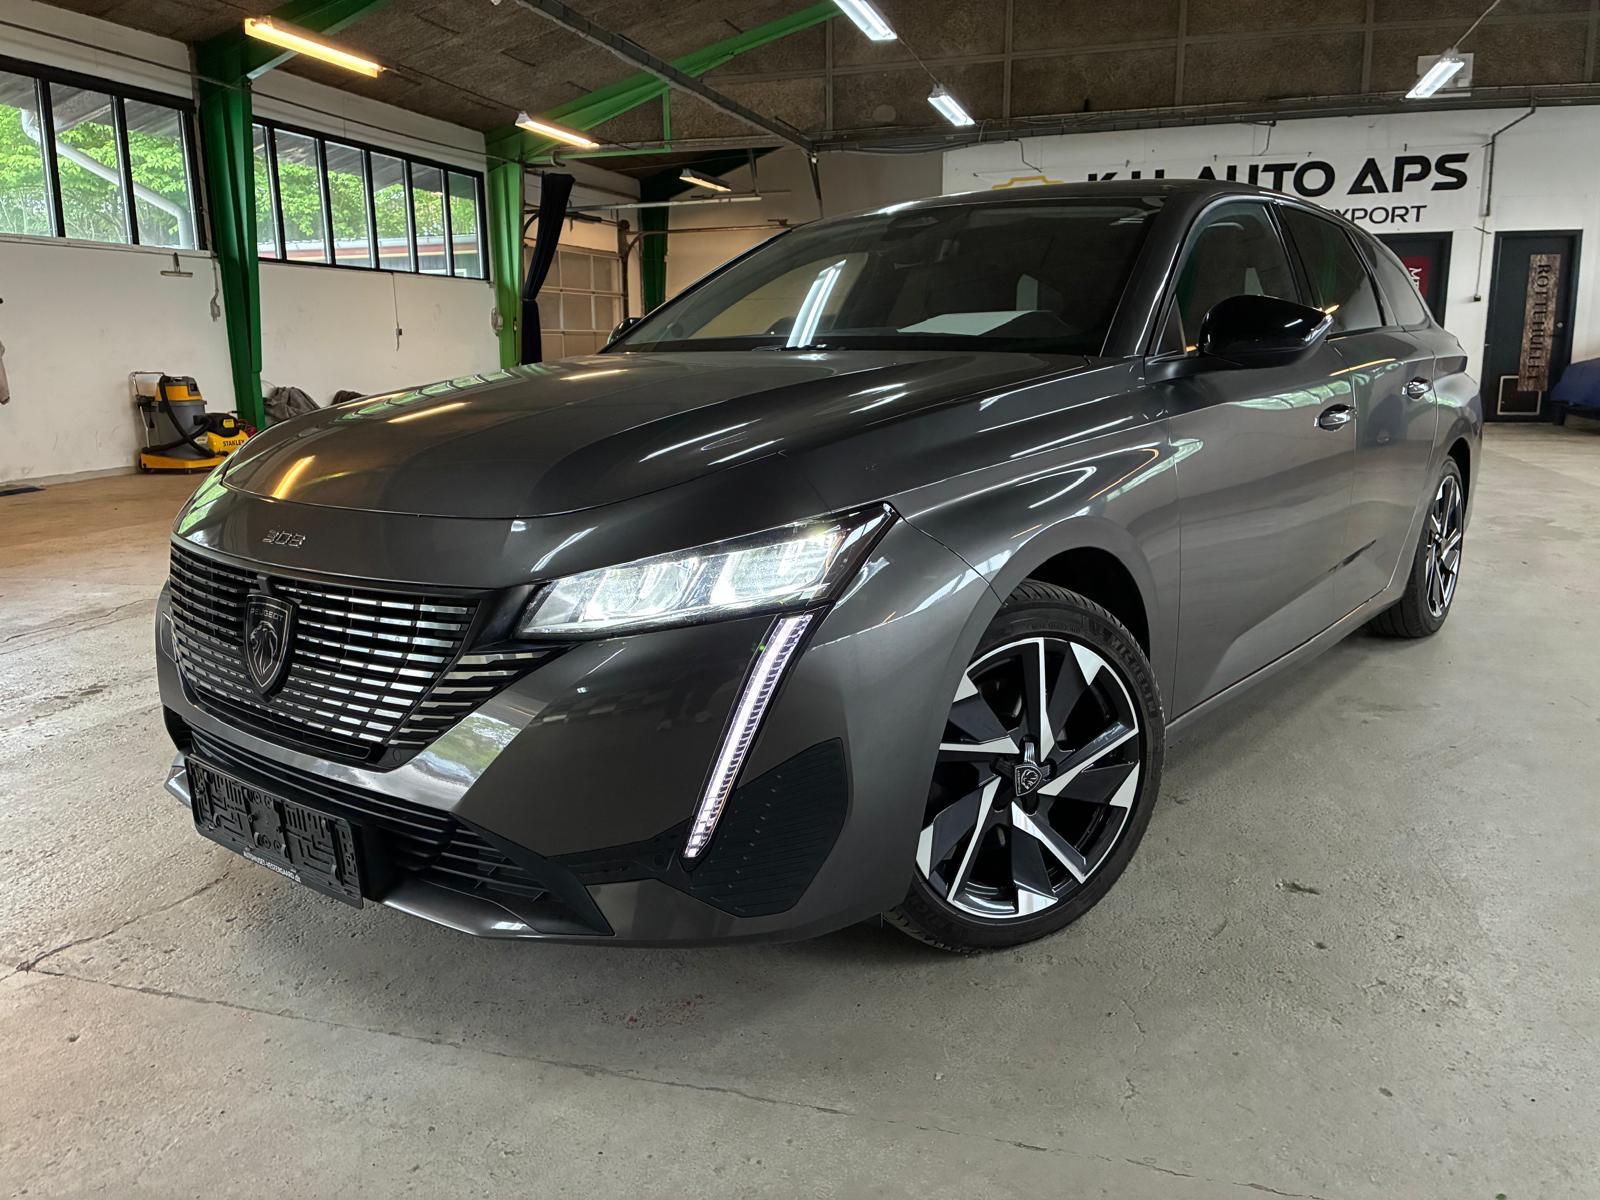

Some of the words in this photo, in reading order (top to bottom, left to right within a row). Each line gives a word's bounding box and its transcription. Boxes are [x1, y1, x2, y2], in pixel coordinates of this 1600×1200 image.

[1347, 153, 1470, 195] APS
[1331, 205, 1427, 224] XPORT
[262, 530, 306, 548] 308
[250, 608, 283, 620] PEUGEOT
